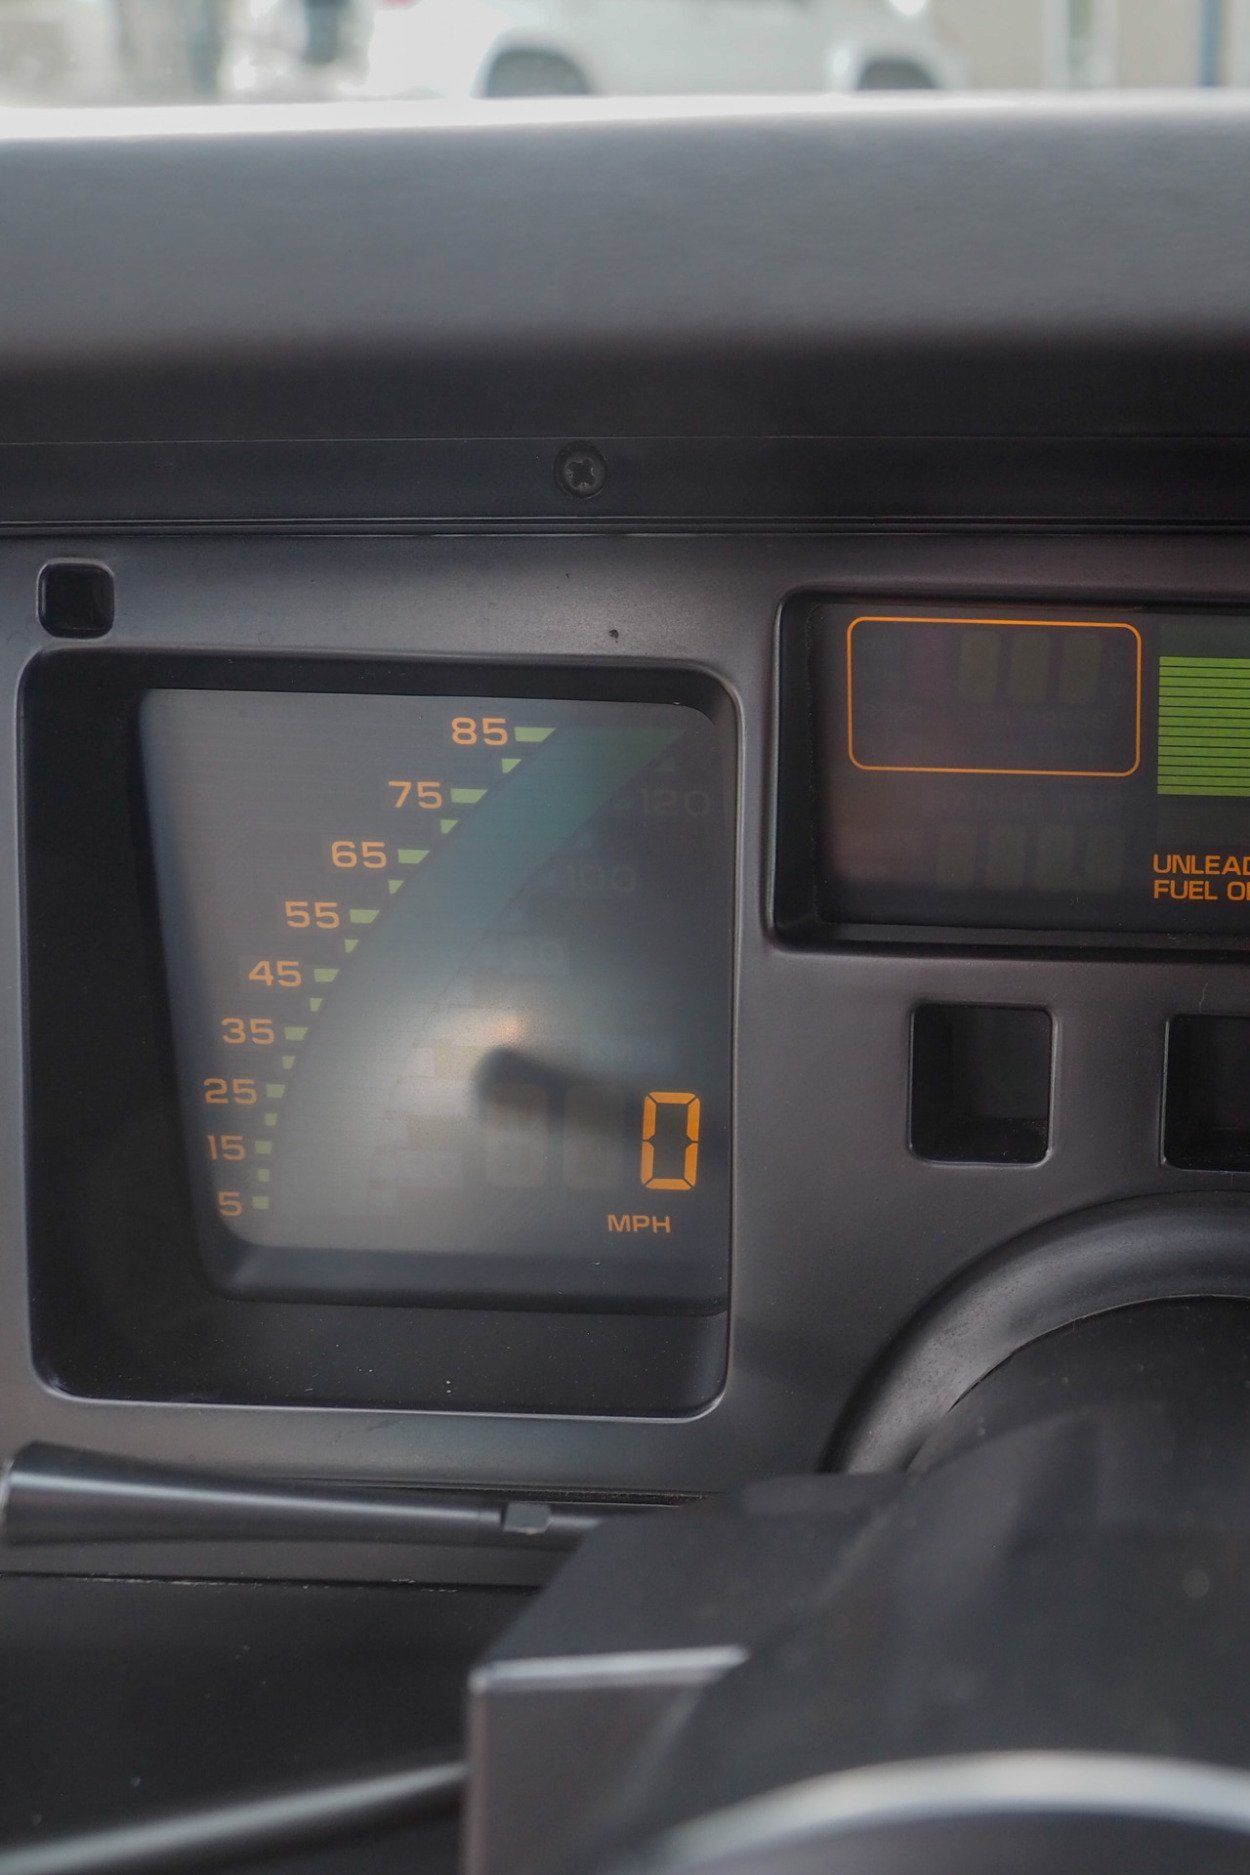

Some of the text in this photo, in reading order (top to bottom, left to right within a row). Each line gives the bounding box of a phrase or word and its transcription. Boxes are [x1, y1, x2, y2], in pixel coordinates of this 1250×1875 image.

[451, 717, 508, 746] 85
[388, 781, 443, 808] 75
[331, 841, 387, 869] 65
[1153, 879, 1218, 901] FUEL
[285, 900, 341, 929] 55
[248, 960, 302, 987] 45
[220, 1017, 275, 1045] 35
[203, 1078, 258, 1105] 25
[206, 1135, 246, 1161] 15
[640, 1091, 701, 1191] 0
[217, 1191, 242, 1216] 5
[606, 1213, 671, 1234] MPH
